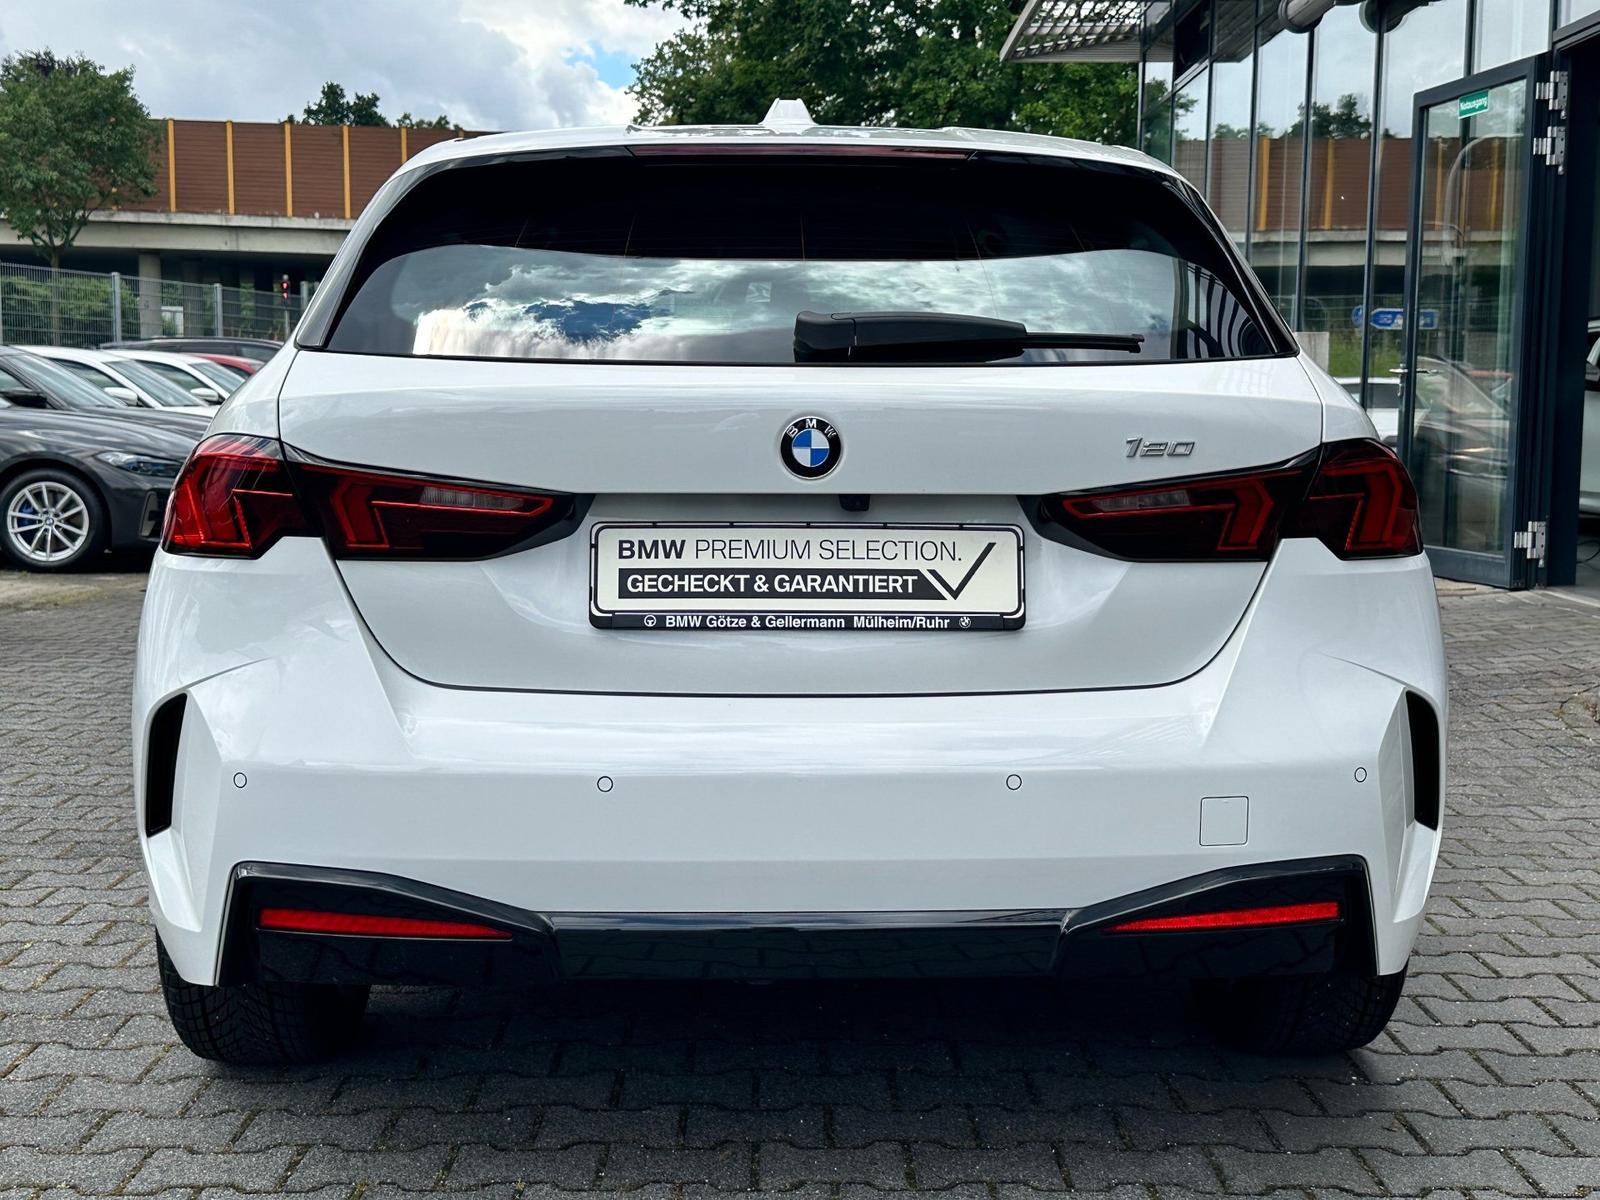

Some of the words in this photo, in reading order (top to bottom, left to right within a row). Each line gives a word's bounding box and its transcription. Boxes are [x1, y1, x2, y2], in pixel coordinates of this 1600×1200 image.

[786, 418, 837, 438] BMW
[1126, 438, 1195, 458] 120
[618, 539, 686, 560] BMW
[695, 539, 811, 560] PREMIUM
[818, 539, 962, 562] SELECTION.
[626, 574, 750, 593] GECHECKT
[753, 574, 770, 593] &
[773, 574, 918, 594] GARANTIERT
[665, 615, 702, 628] BMW
[706, 614, 747, 628] Götze
[750, 615, 762, 628] &
[765, 615, 845, 628] Gellermann
[853, 615, 950, 629] Mülheim/Ruhr
